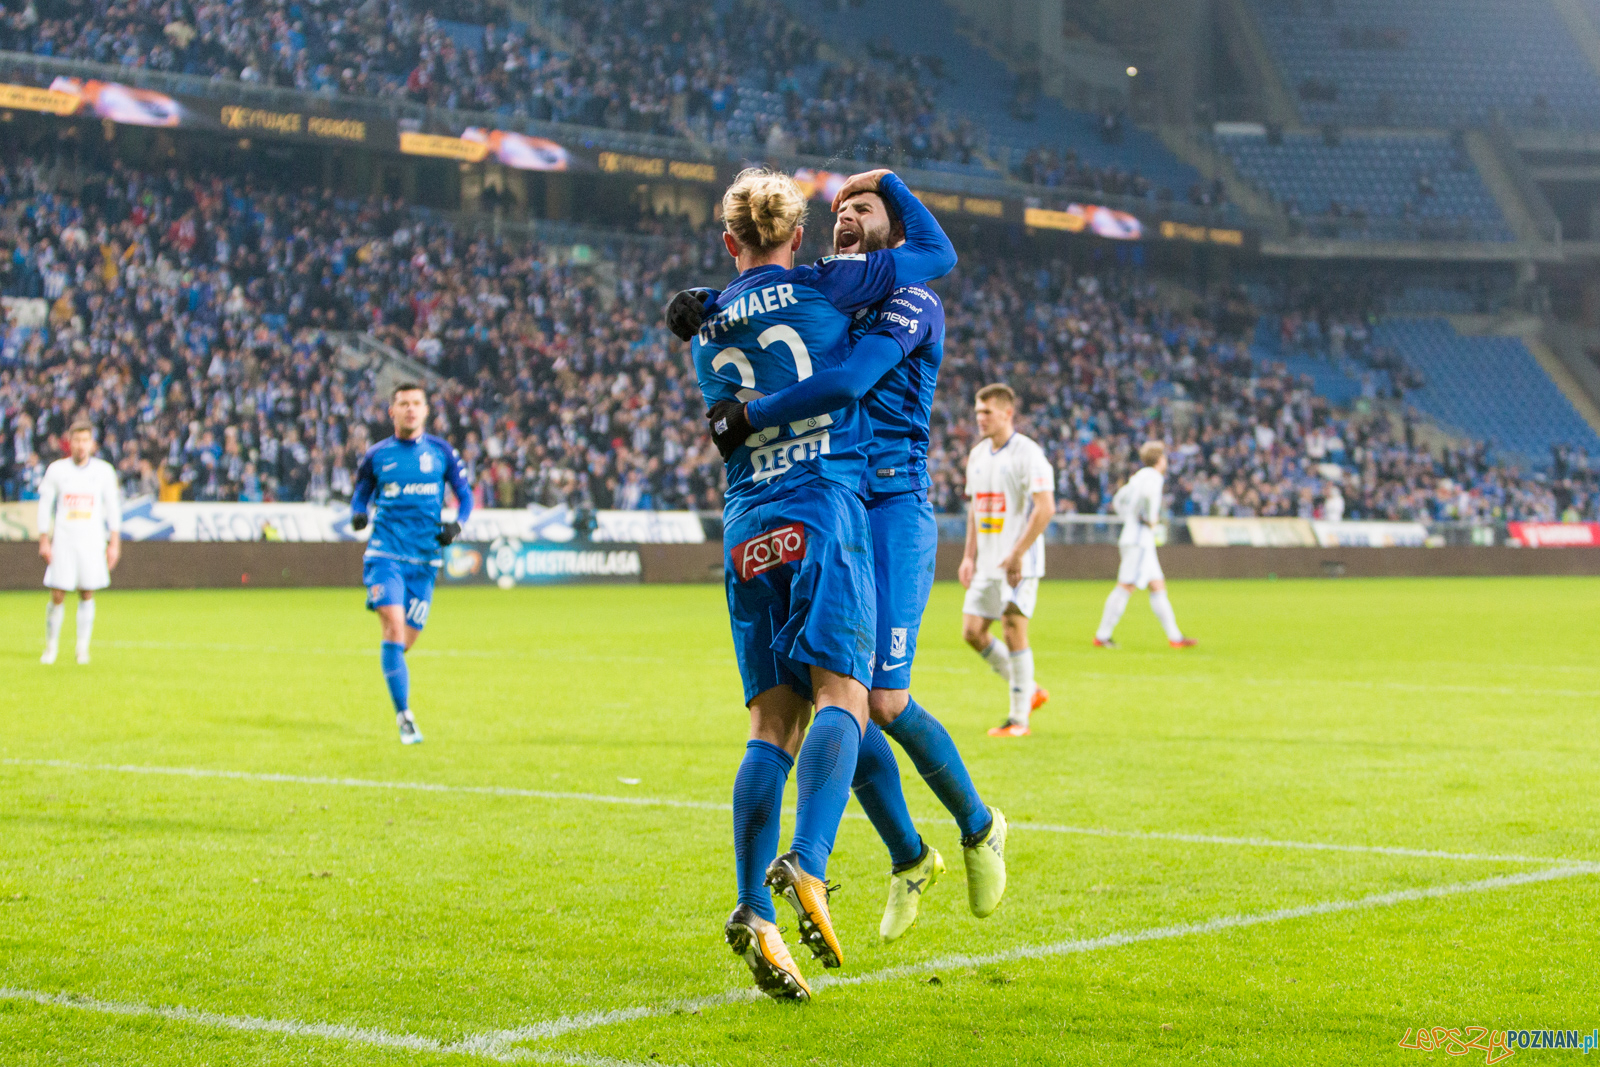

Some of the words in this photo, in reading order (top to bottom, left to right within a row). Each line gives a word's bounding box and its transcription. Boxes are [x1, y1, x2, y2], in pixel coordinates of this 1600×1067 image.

[758, 440, 822, 473] LECH
[526, 550, 642, 575] EKSTRAKLASA
[406, 597, 429, 624] 10
